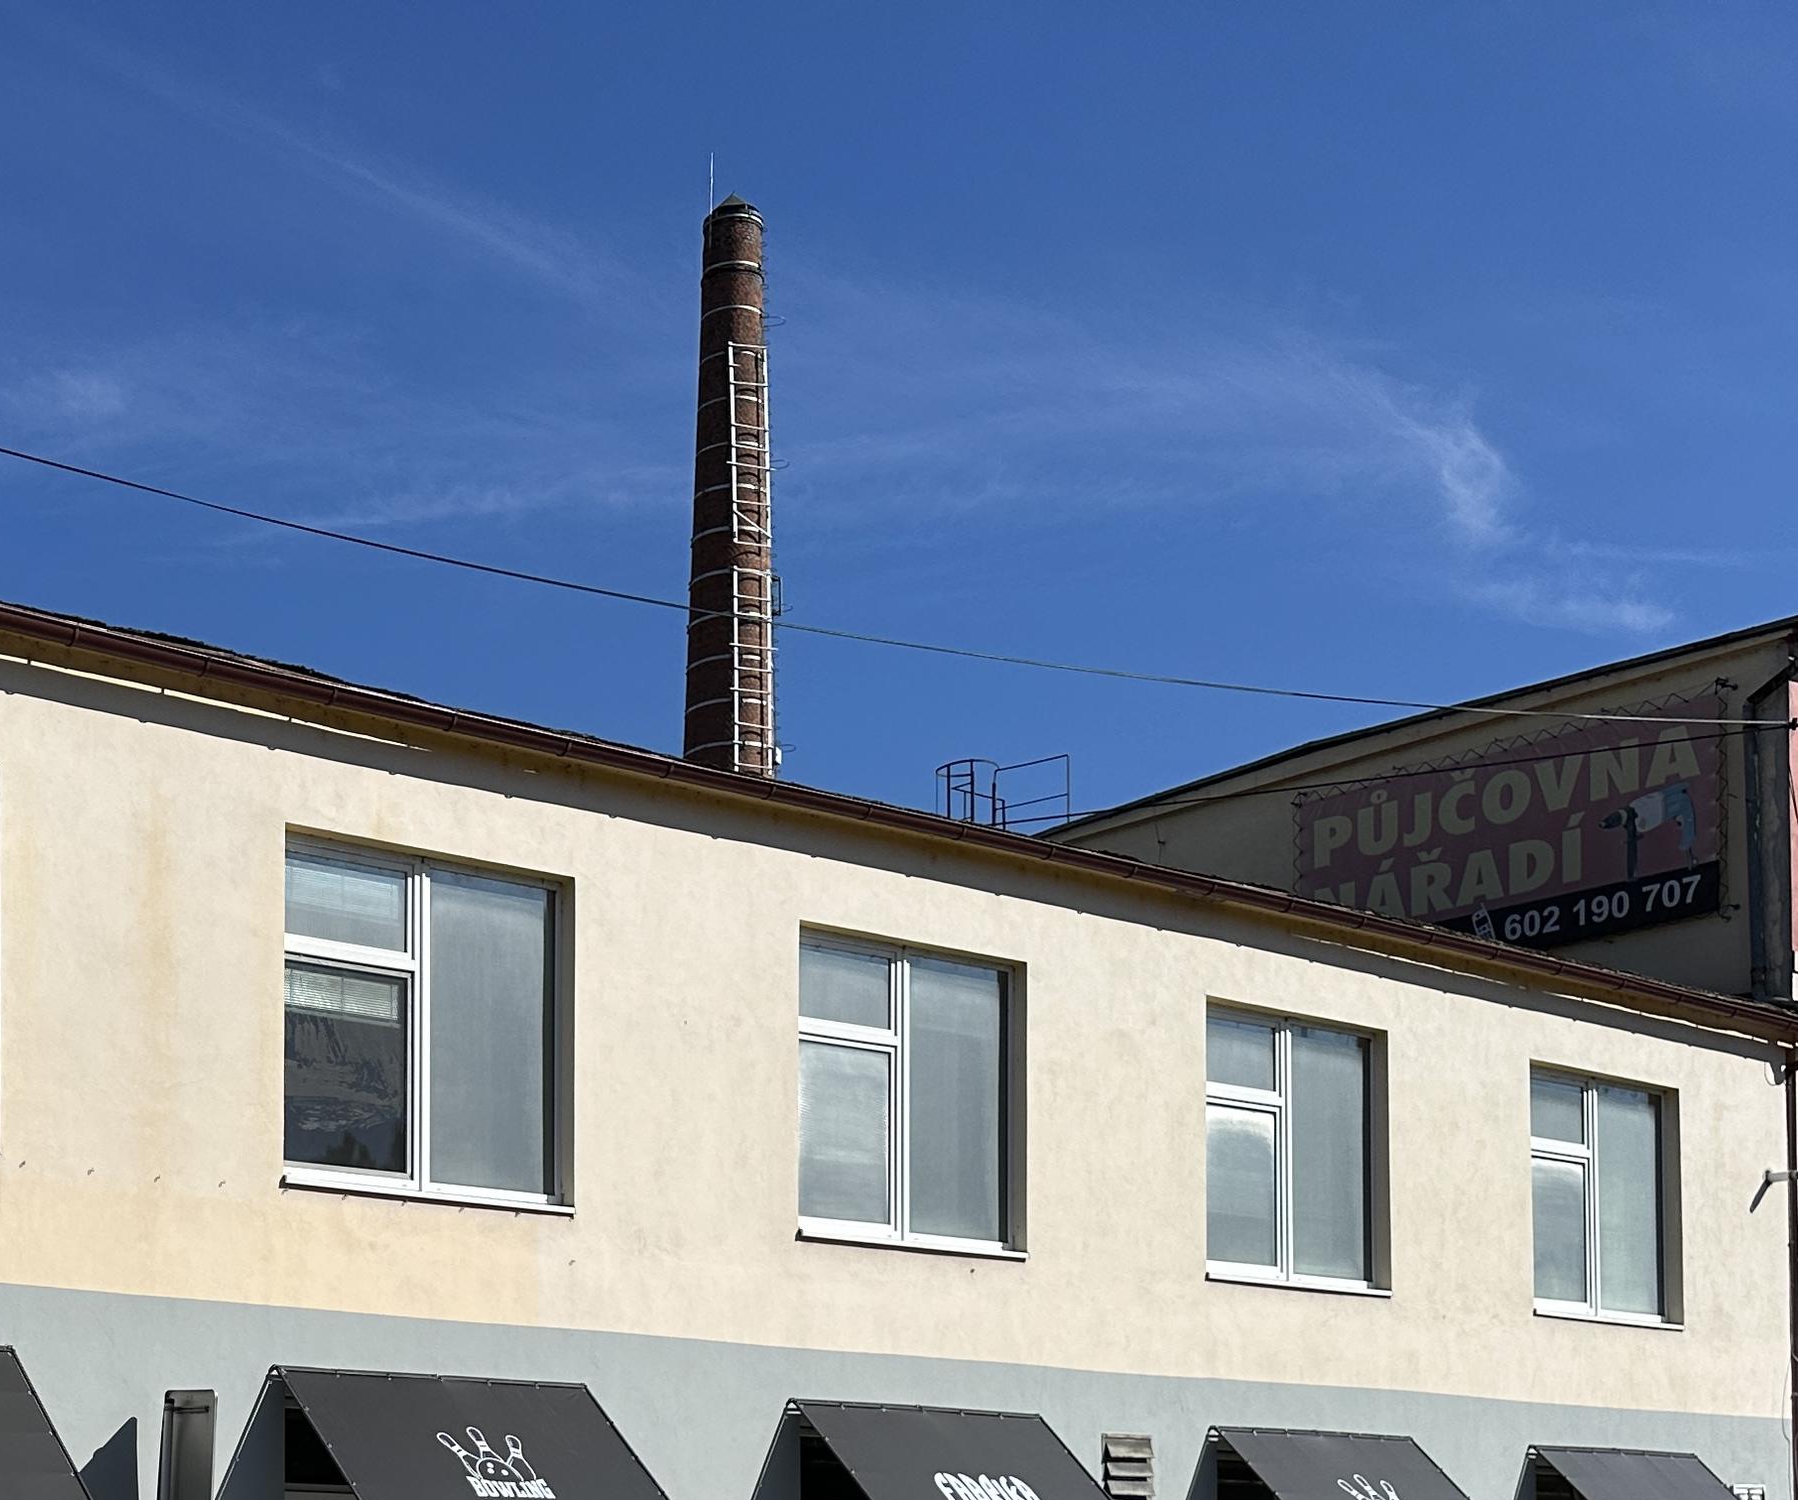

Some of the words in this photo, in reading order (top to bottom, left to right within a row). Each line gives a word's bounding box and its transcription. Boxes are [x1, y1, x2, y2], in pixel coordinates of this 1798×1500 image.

[1314, 724, 1700, 869] PŮJČOVNA
[1505, 906, 1560, 941] 602
[1573, 890, 1630, 926] 190
[1642, 875, 1701, 912] 707
[466, 1475, 557, 1500] BOWLING
